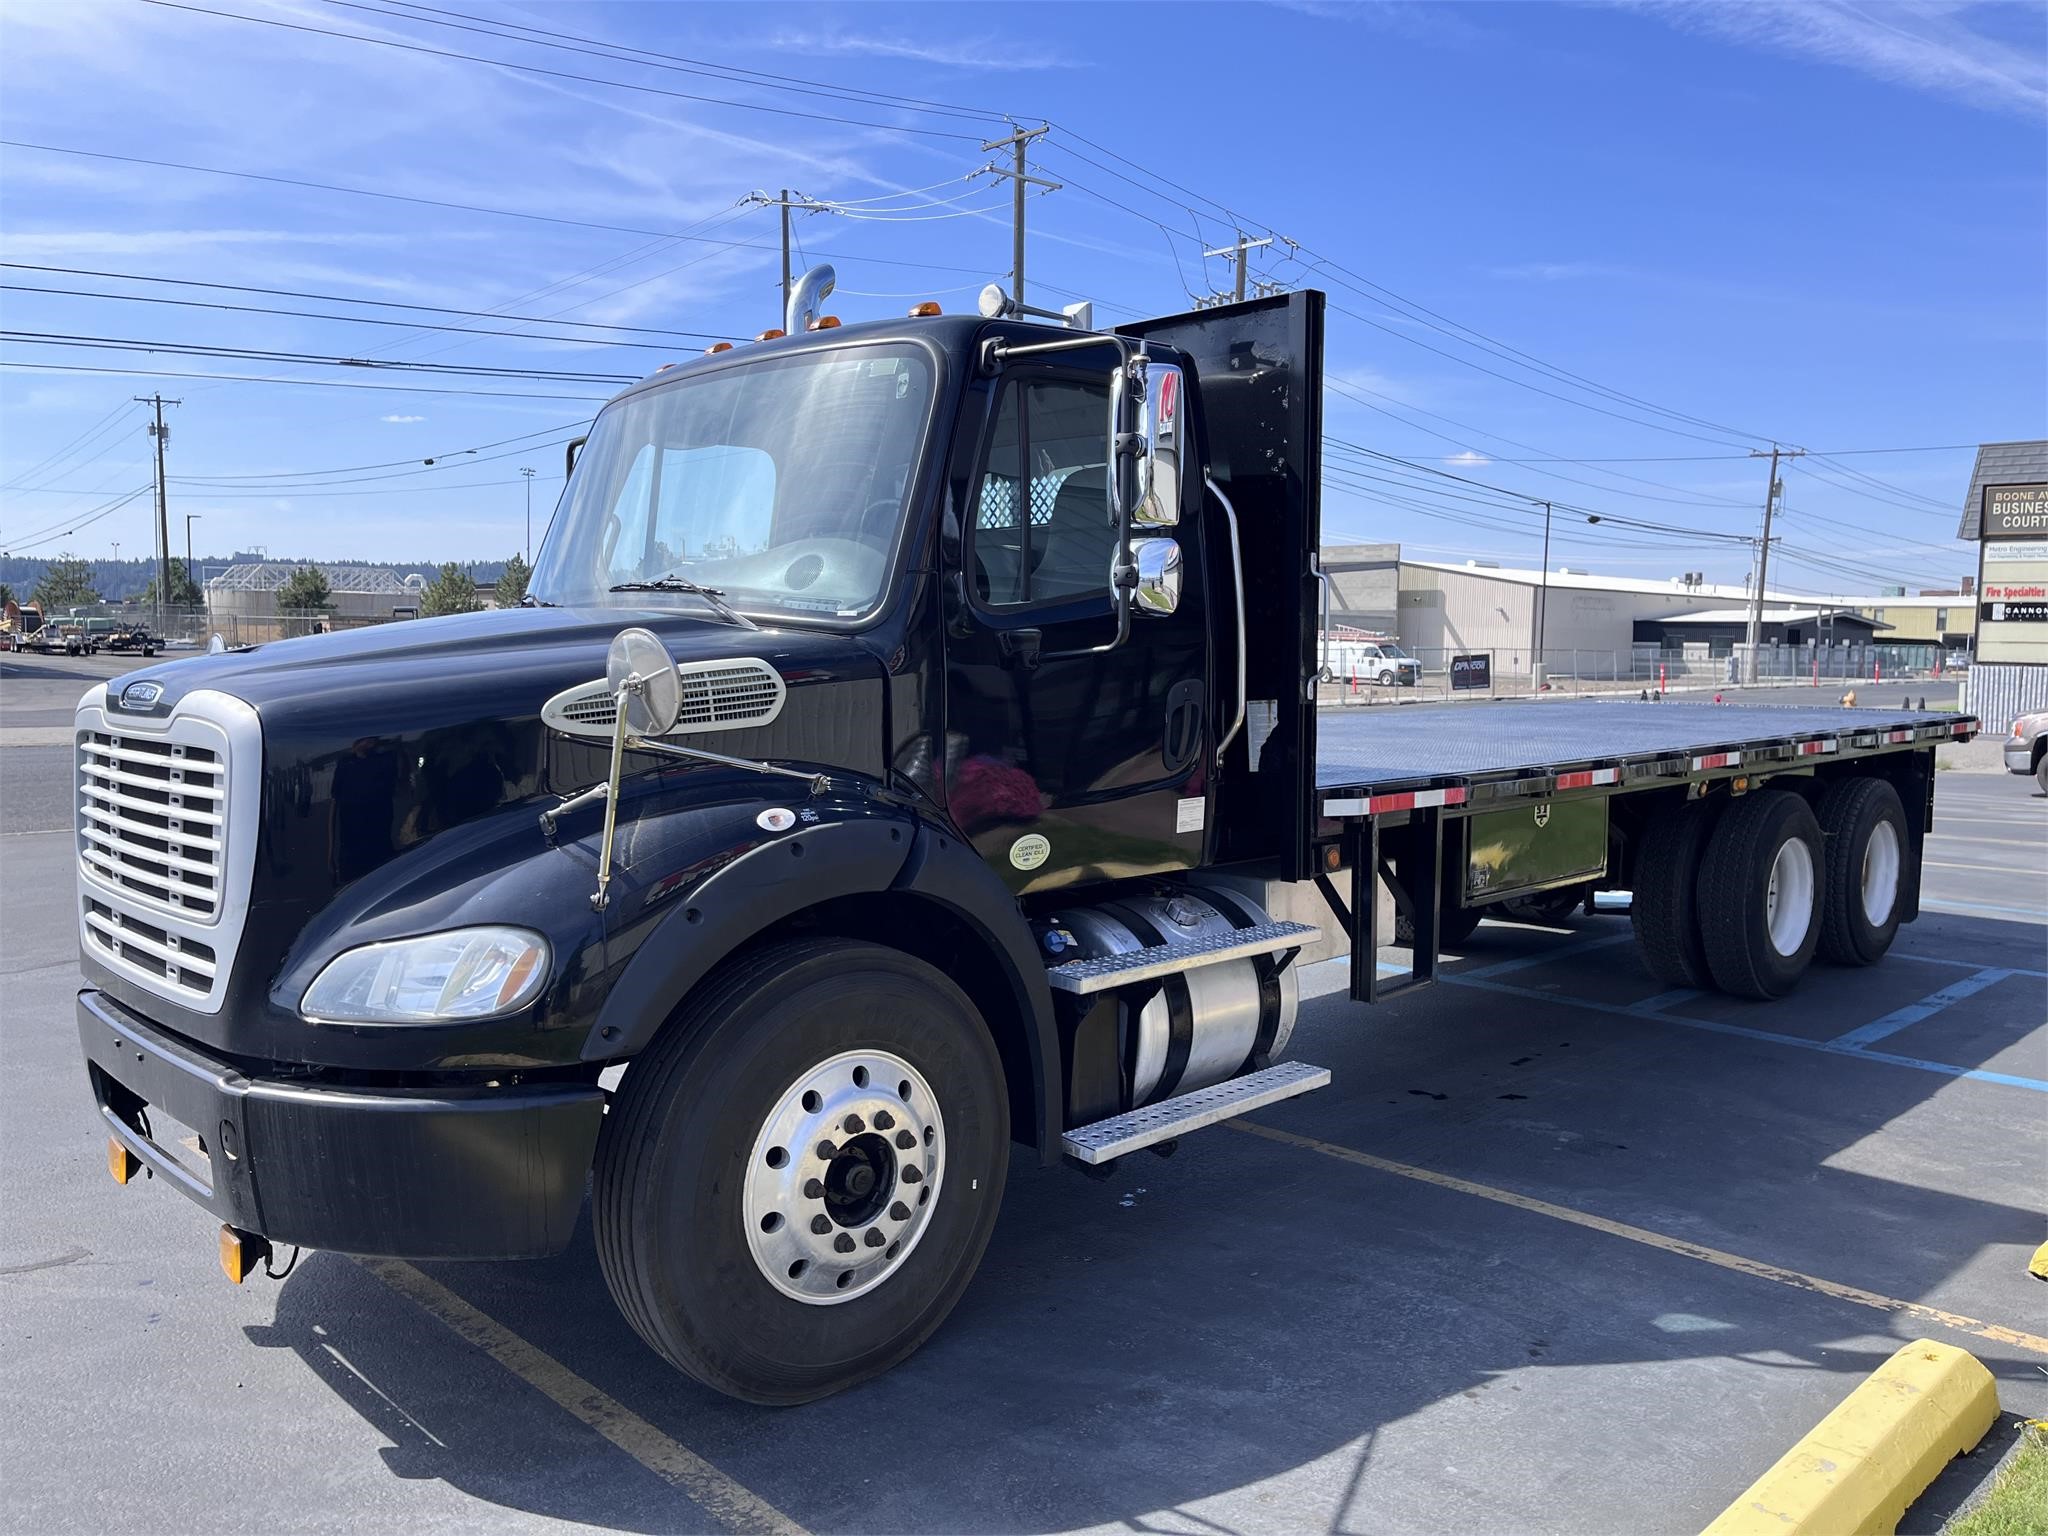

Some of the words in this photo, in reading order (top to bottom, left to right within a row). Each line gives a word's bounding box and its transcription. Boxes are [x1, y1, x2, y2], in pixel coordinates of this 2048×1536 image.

[1996, 491, 2035, 502] BOONE
[2002, 515, 2048, 528] COURT
[1986, 586, 2001, 597] Fire
[2004, 587, 2045, 599] Specialties
[1018, 843, 1043, 852] CERTIFIED
[1016, 851, 1033, 859] CLEAN
